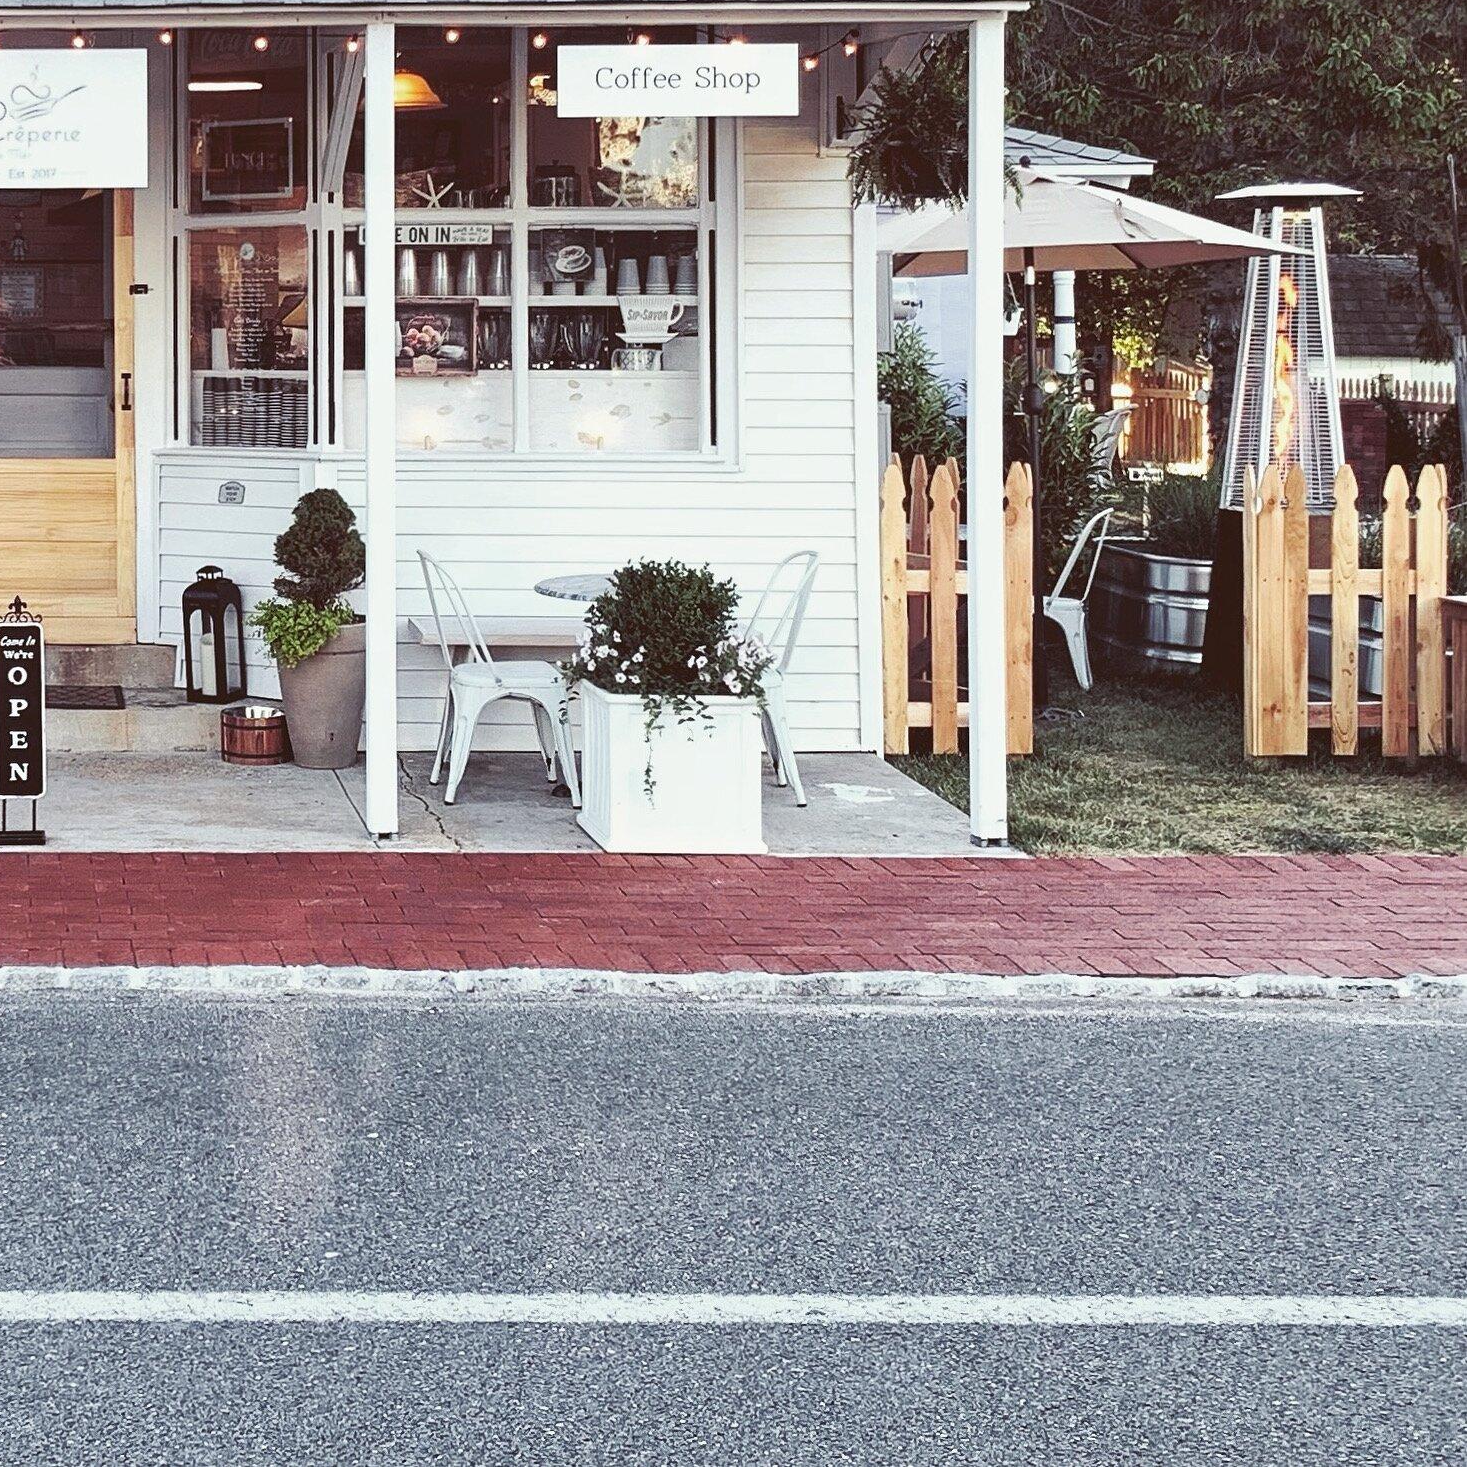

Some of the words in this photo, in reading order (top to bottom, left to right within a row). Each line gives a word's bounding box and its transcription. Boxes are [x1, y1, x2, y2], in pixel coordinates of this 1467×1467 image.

[595, 67, 681, 89] Coffee
[695, 65, 761, 94] Shop
[408, 226, 429, 243] ON
[435, 226, 451, 243] IN
[0, 635, 24, 647] Come
[25, 635, 36, 646] In
[3, 649, 34, 660] We're
[7, 666, 29, 782] OPEN
